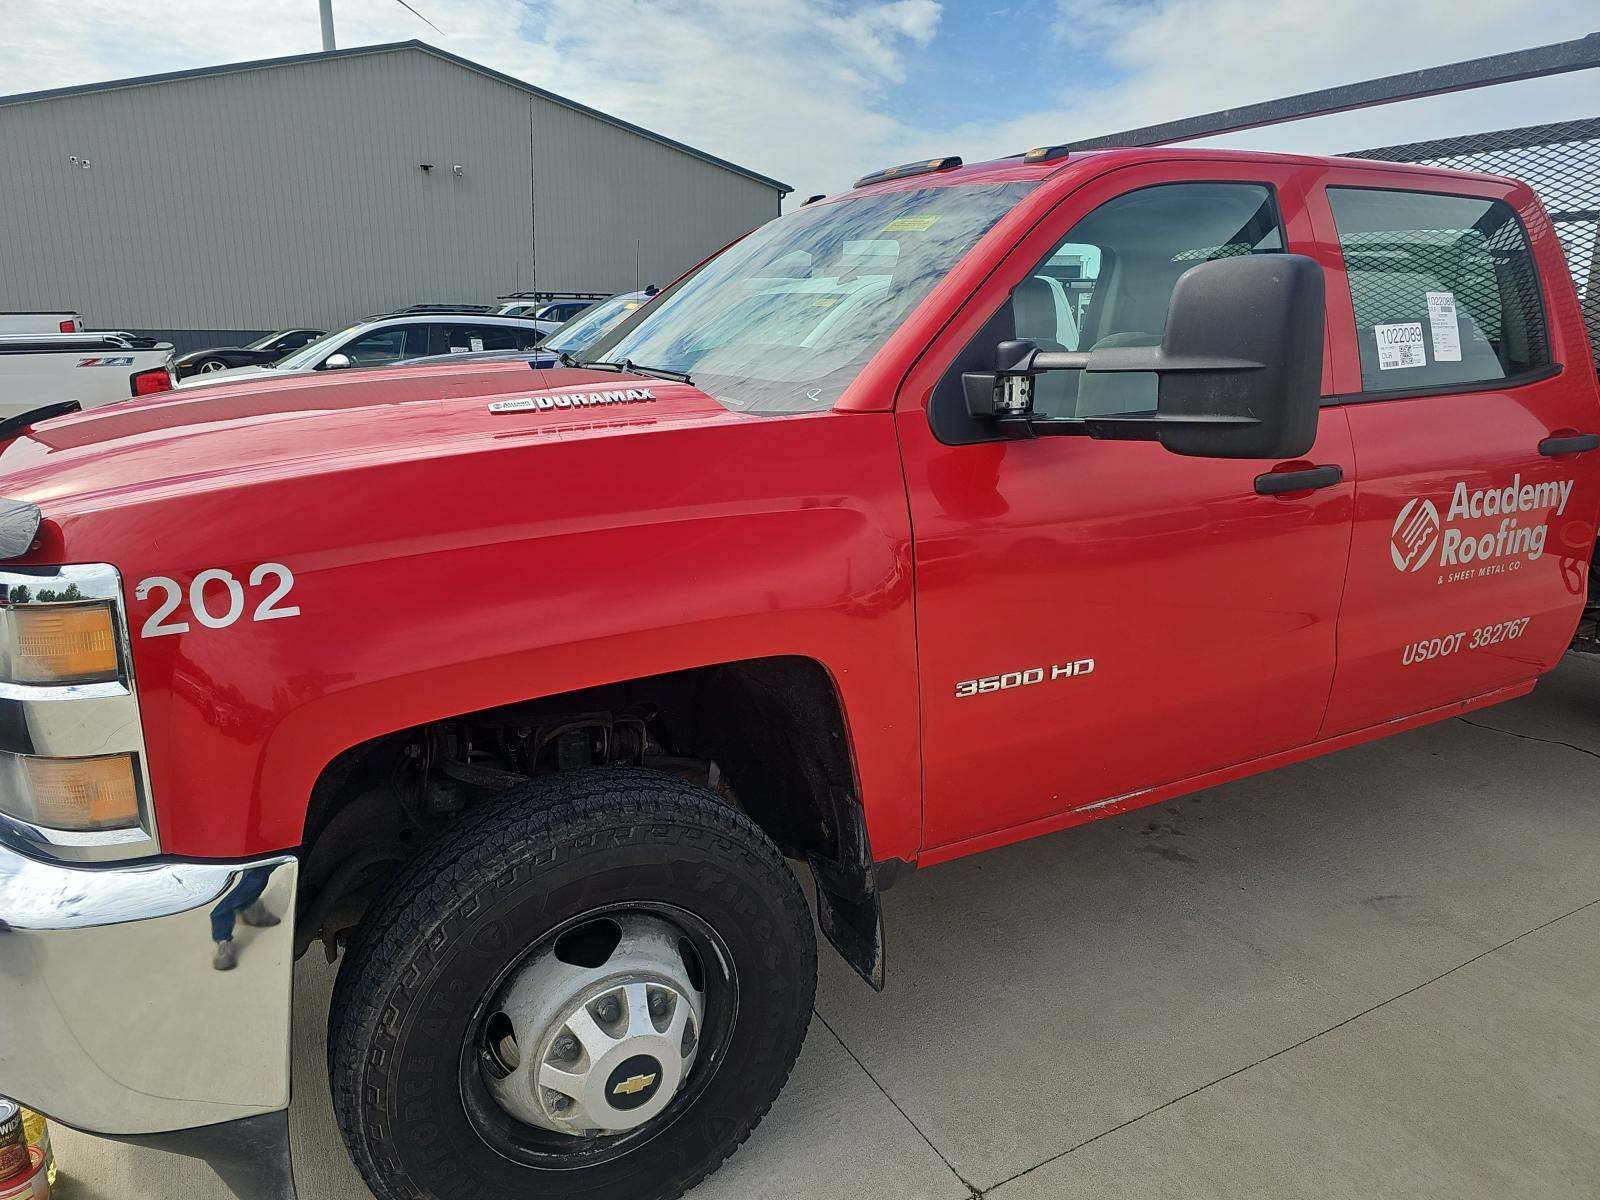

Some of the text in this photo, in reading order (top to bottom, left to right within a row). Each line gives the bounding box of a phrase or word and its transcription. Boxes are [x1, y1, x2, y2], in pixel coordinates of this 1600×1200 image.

[1381, 327, 1422, 344] 1022089
[537, 388, 656, 411] DURAMAX
[1446, 473, 1574, 521] Academy
[1439, 518, 1548, 567] Roofing
[1437, 575, 1444, 584] &
[1448, 569, 1475, 583] SHEET
[1478, 566, 1505, 577] METAL
[135, 562, 301, 639] 202
[1402, 617, 1530, 666] USDOT 382767
[955, 658, 1095, 698] 3500 HD
